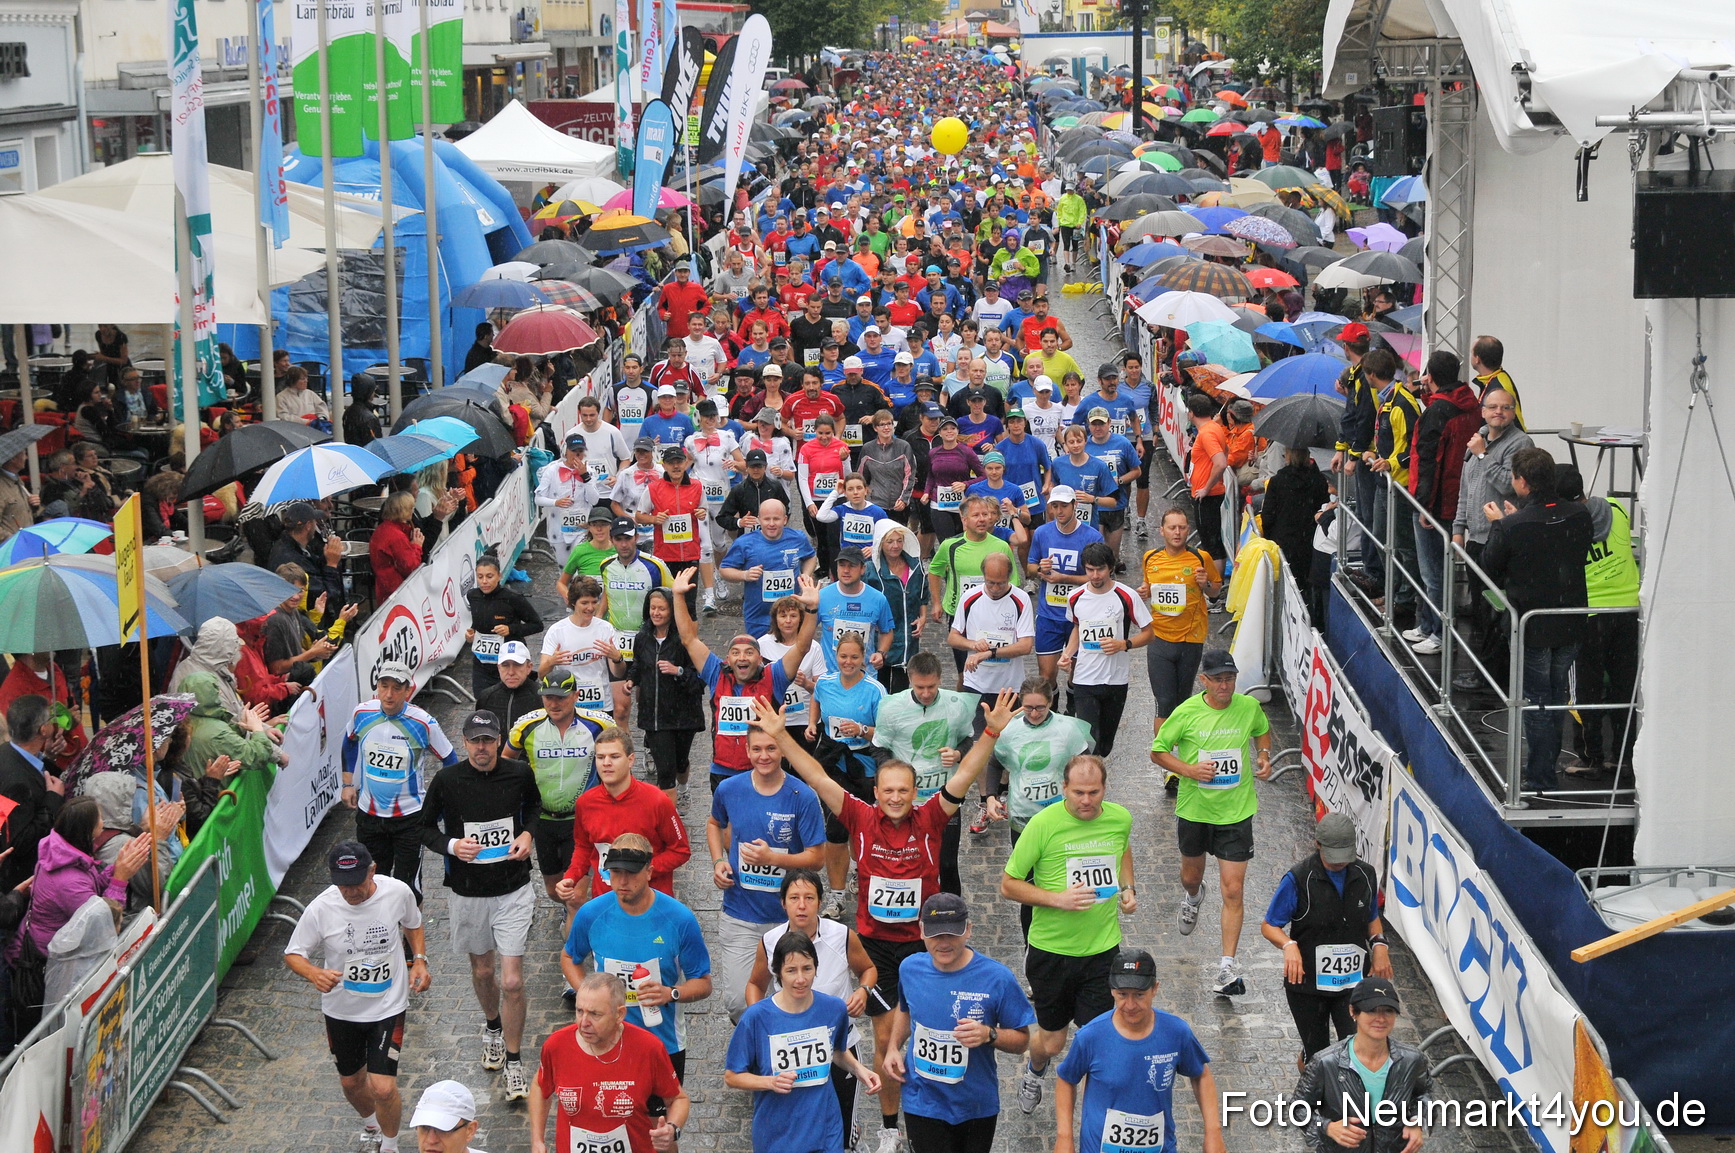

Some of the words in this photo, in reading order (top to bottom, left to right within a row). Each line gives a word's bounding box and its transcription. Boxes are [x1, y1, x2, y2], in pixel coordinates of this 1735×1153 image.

[732, 120, 745, 158] Audi
[740, 84, 751, 117] BKK
[497, 166, 574, 175] www.audibkk.de
[621, 409, 642, 418] 3059
[668, 521, 687, 533] 468
[846, 520, 871, 534] 2420
[609, 580, 646, 591] BOCK
[765, 577, 793, 591] 2942
[1052, 585, 1074, 597] 435
[1158, 591, 1180, 605] 565
[1082, 626, 1115, 642] 2144
[474, 639, 500, 654] 2579
[578, 686, 601, 702] 945
[721, 706, 751, 722] 2901
[539, 740, 571, 748] TEAM
[368, 751, 404, 771] 2247
[537, 747, 588, 759] BOCK
[1023, 782, 1058, 801] 2776
[671, 815, 682, 840] SIEMENS
[745, 875, 775, 886] Christoph
[1072, 867, 1114, 887] 3100
[873, 888, 916, 907] 2744
[348, 962, 391, 982] 3375
[1321, 954, 1360, 974] 2439
[134, 1009, 154, 1048] Mehr
[776, 1042, 828, 1070] 3175
[918, 1038, 962, 1064] 3315
[927, 1064, 948, 1076] Josef
[1109, 1123, 1159, 1146] 3325
